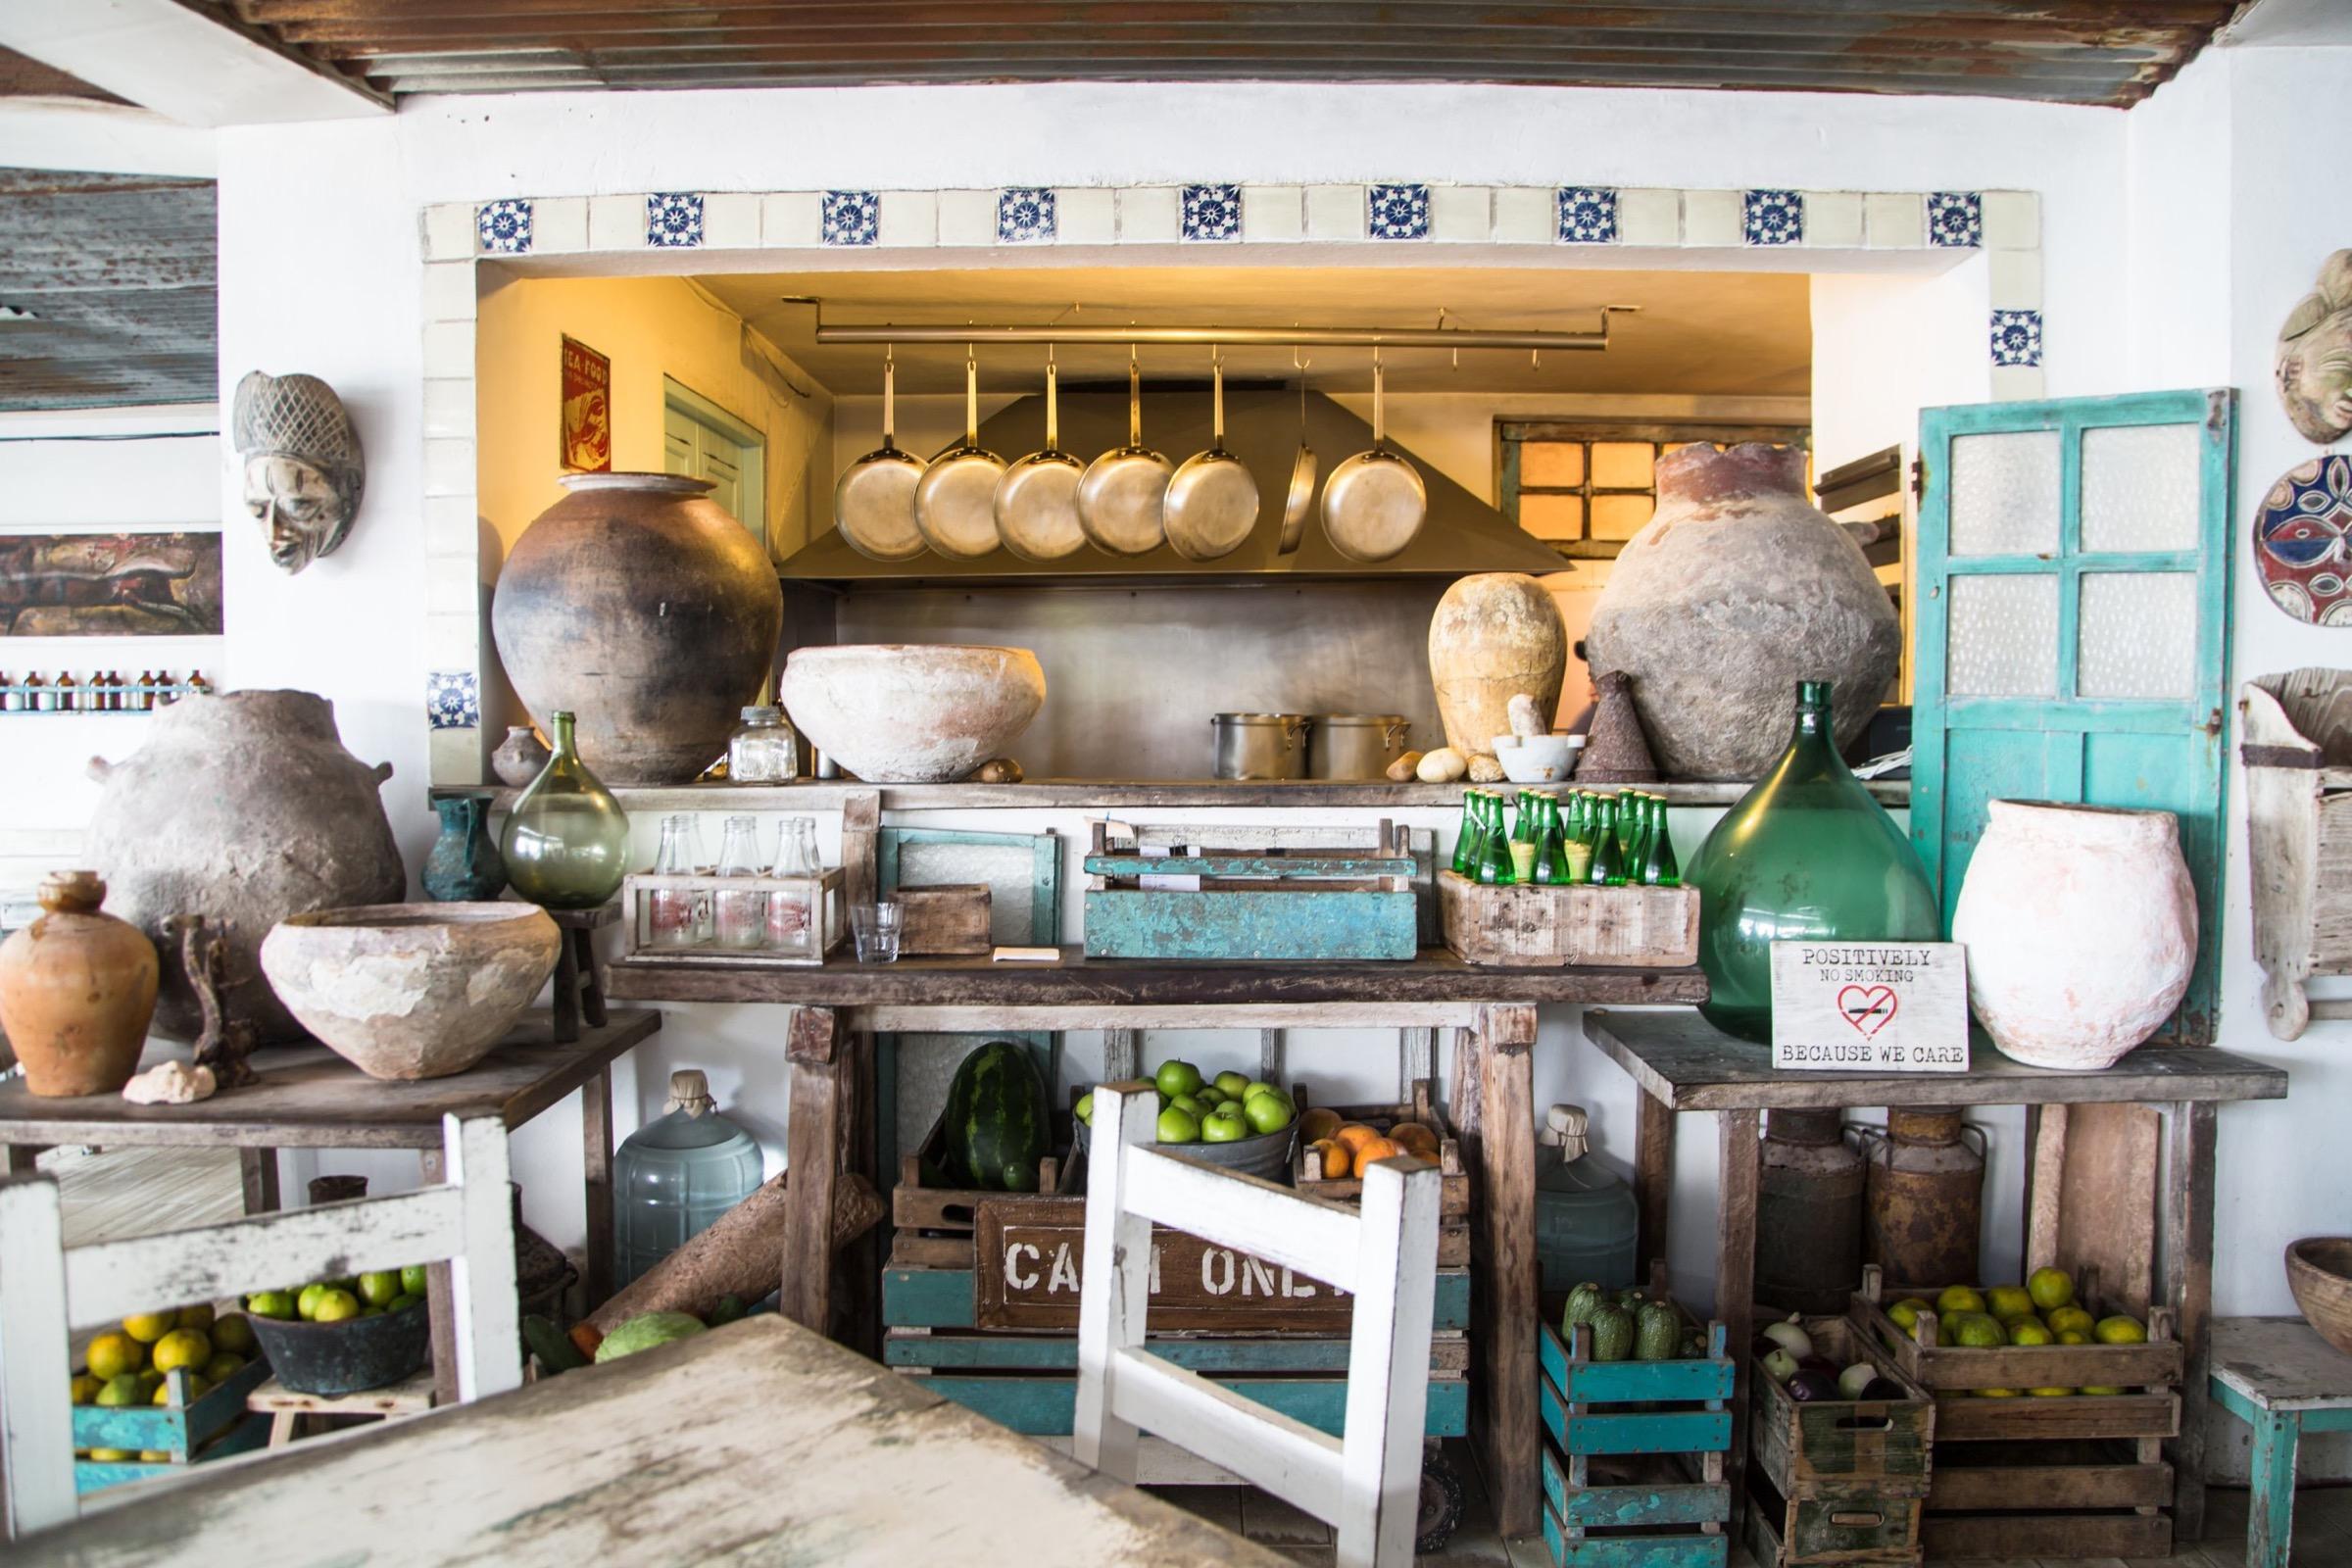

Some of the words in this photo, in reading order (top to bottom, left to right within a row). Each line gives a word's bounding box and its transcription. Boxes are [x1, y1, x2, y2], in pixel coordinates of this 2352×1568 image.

[1801, 948, 1932, 966] POSITIVELY
[1820, 968, 1839, 982] NO
[1844, 968, 1915, 983] SMOKING
[1782, 1045, 1873, 1062] BECAUSE
[1880, 1046, 1905, 1062] WE
[1913, 1046, 1964, 1063] CARE
[1004, 1242, 1161, 1295] CA
[1200, 1246, 1347, 1298] ONL
